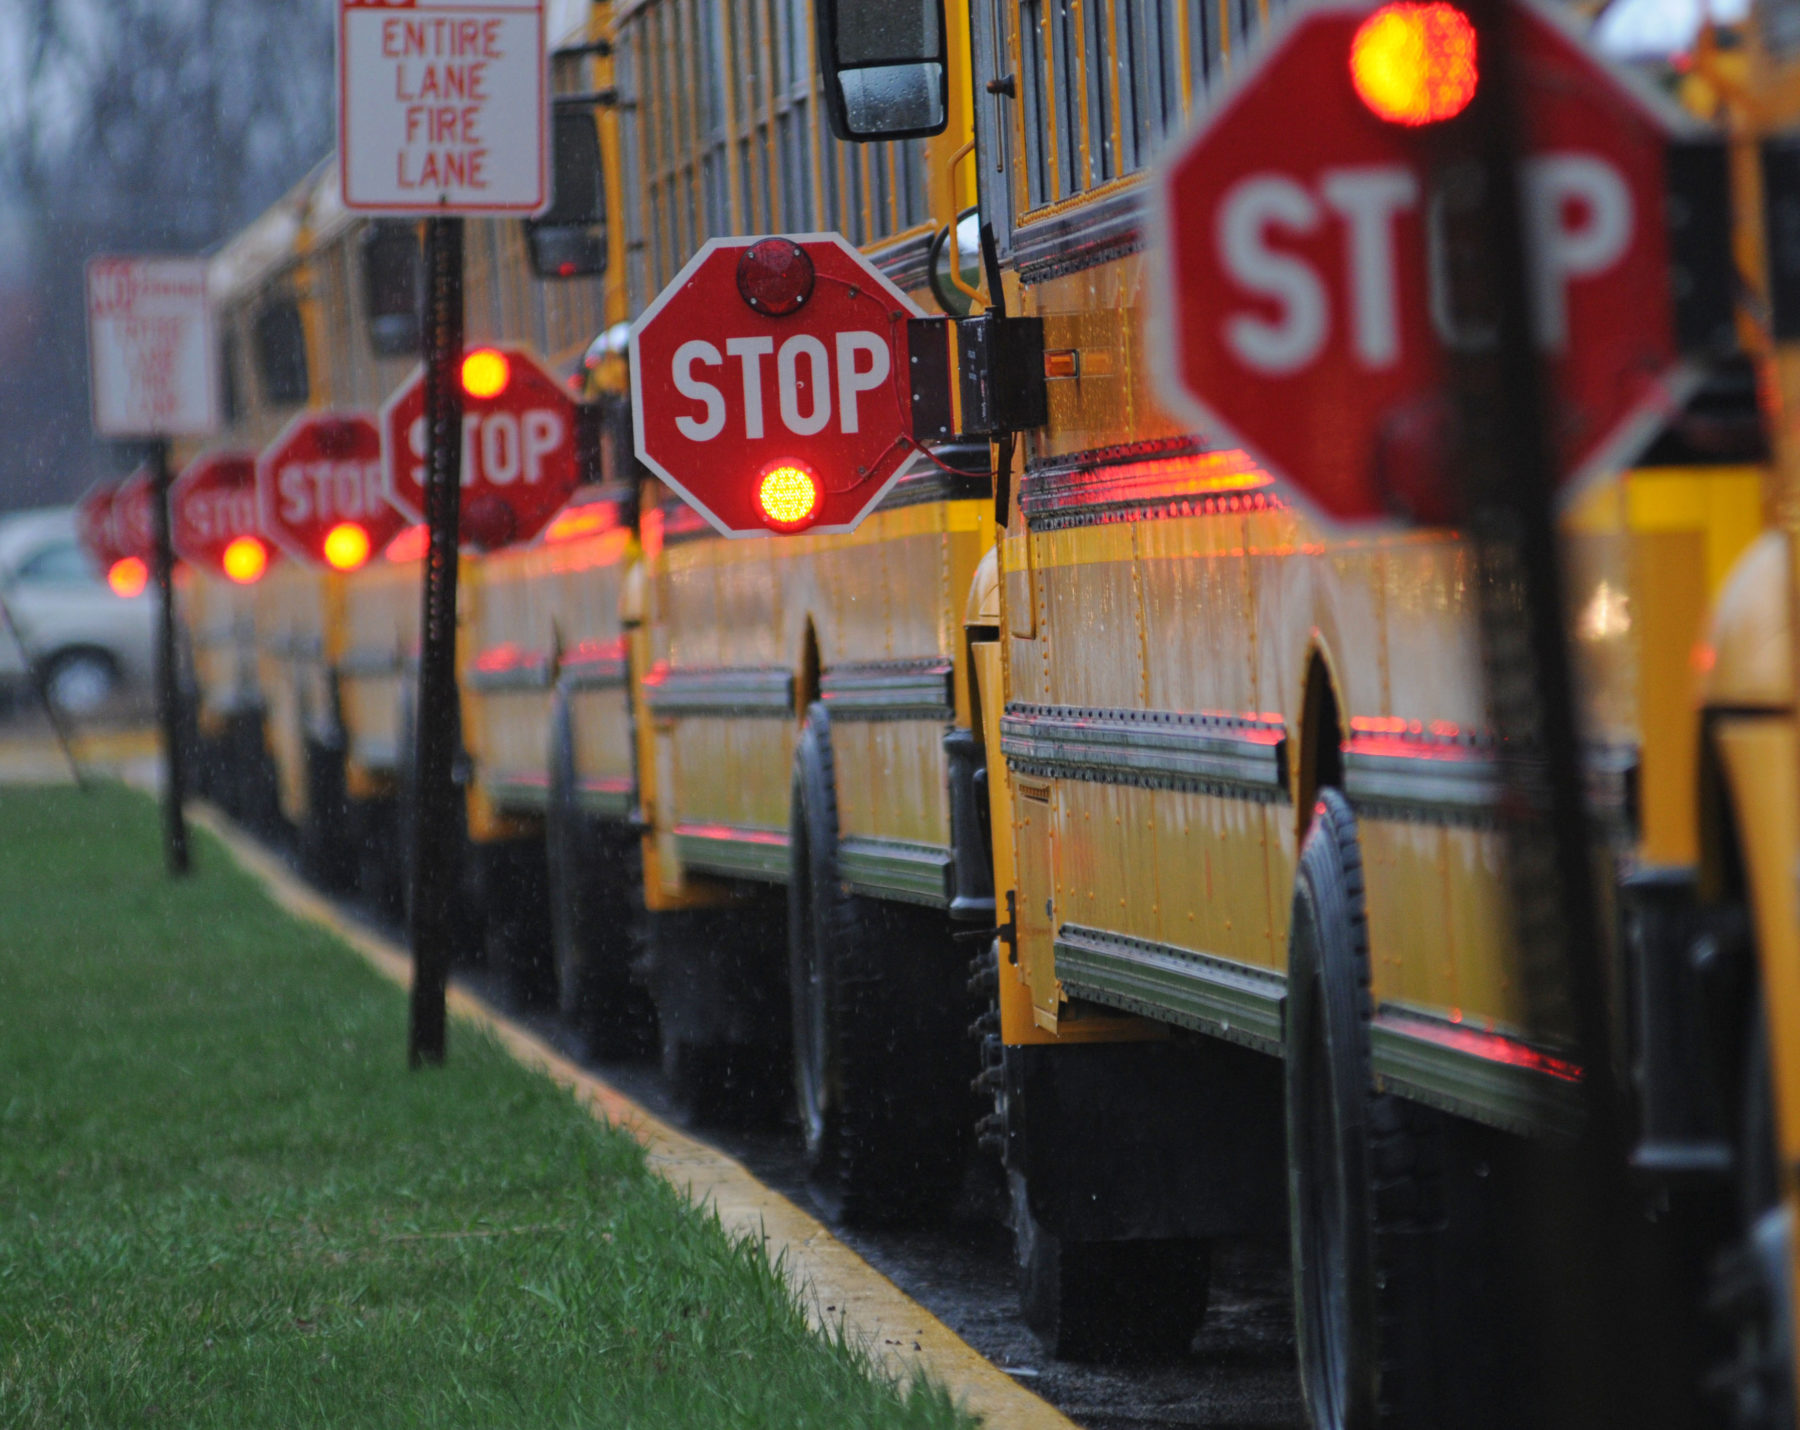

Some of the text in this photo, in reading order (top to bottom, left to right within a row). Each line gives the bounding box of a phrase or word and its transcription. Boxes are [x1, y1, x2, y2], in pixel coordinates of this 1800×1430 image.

[382, 17, 505, 59] ENTIRE
[395, 61, 489, 101] LANE
[405, 105, 482, 145] FIRE
[396, 148, 488, 189] LANE
[671, 330, 892, 442] STOP
